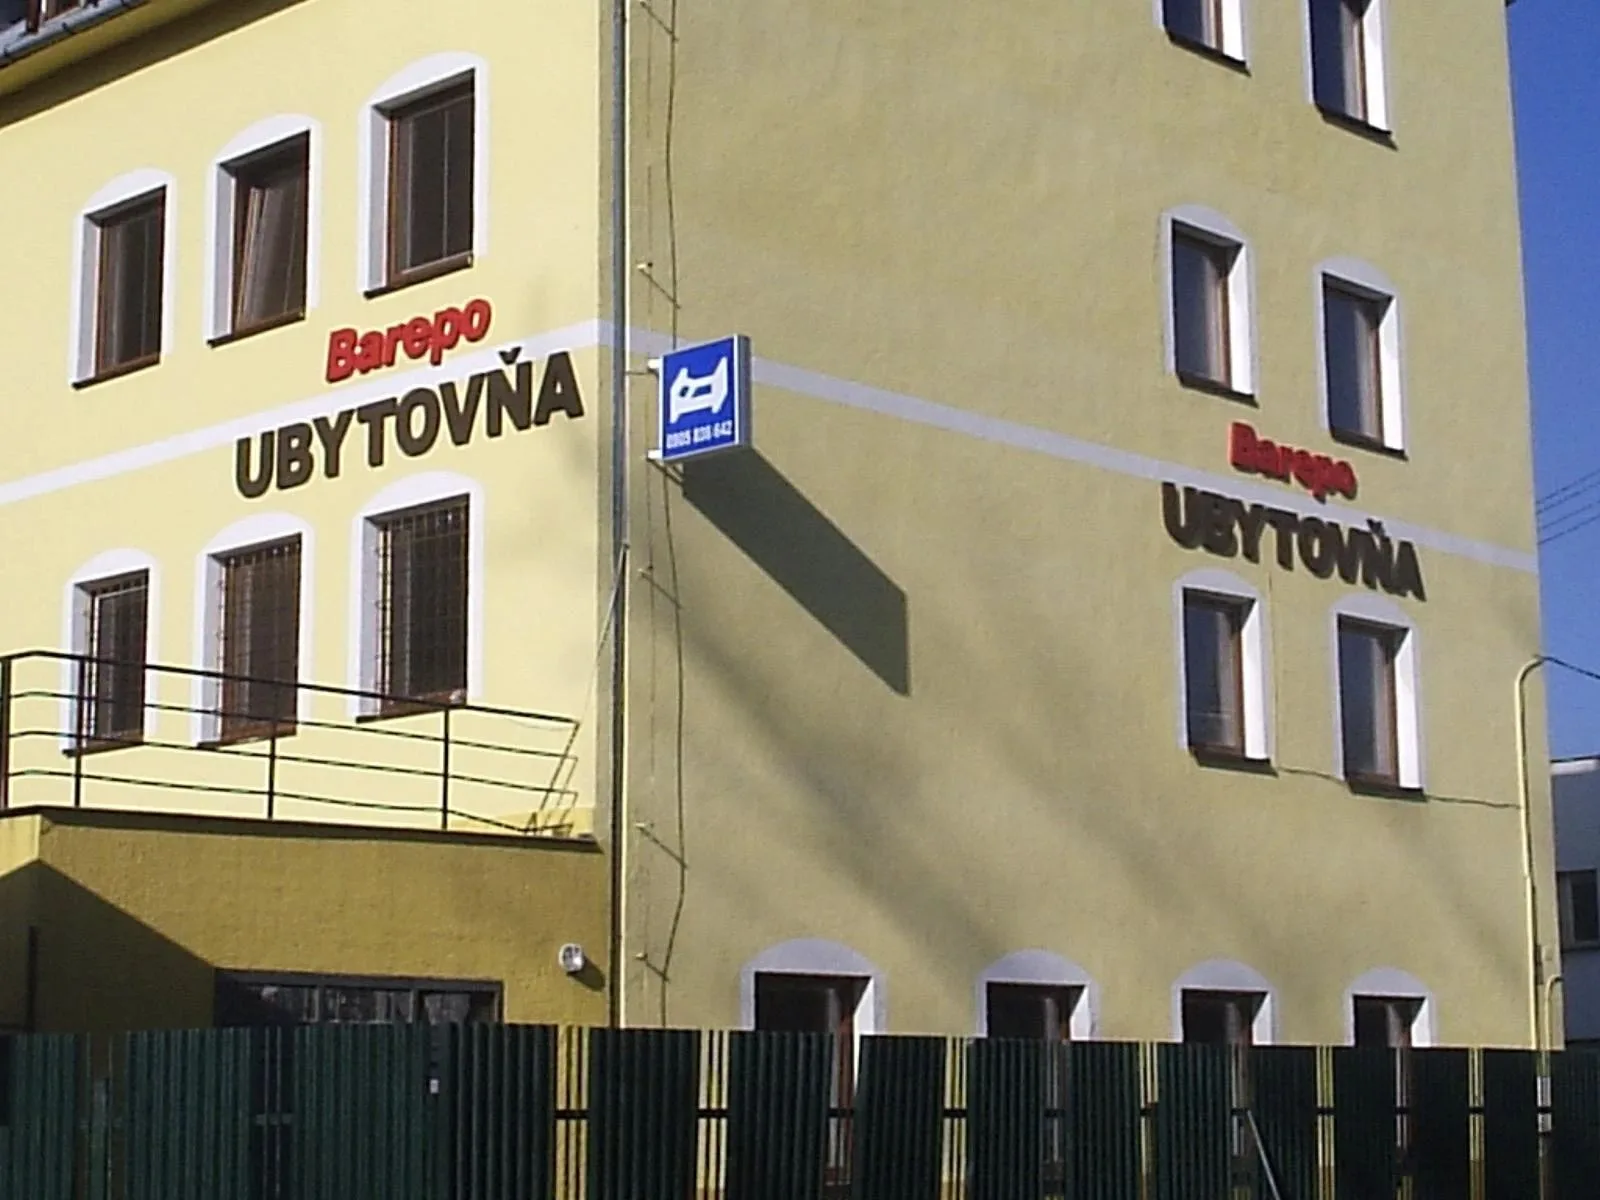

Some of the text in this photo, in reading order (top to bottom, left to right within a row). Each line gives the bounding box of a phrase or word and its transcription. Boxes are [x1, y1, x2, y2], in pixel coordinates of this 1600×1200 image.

[325, 299, 492, 383] Barepo
[235, 346, 585, 499] UBYTOVŇA
[1230, 421, 1357, 504] Barepo
[1162, 481, 1427, 602] UBYTOVŇA
